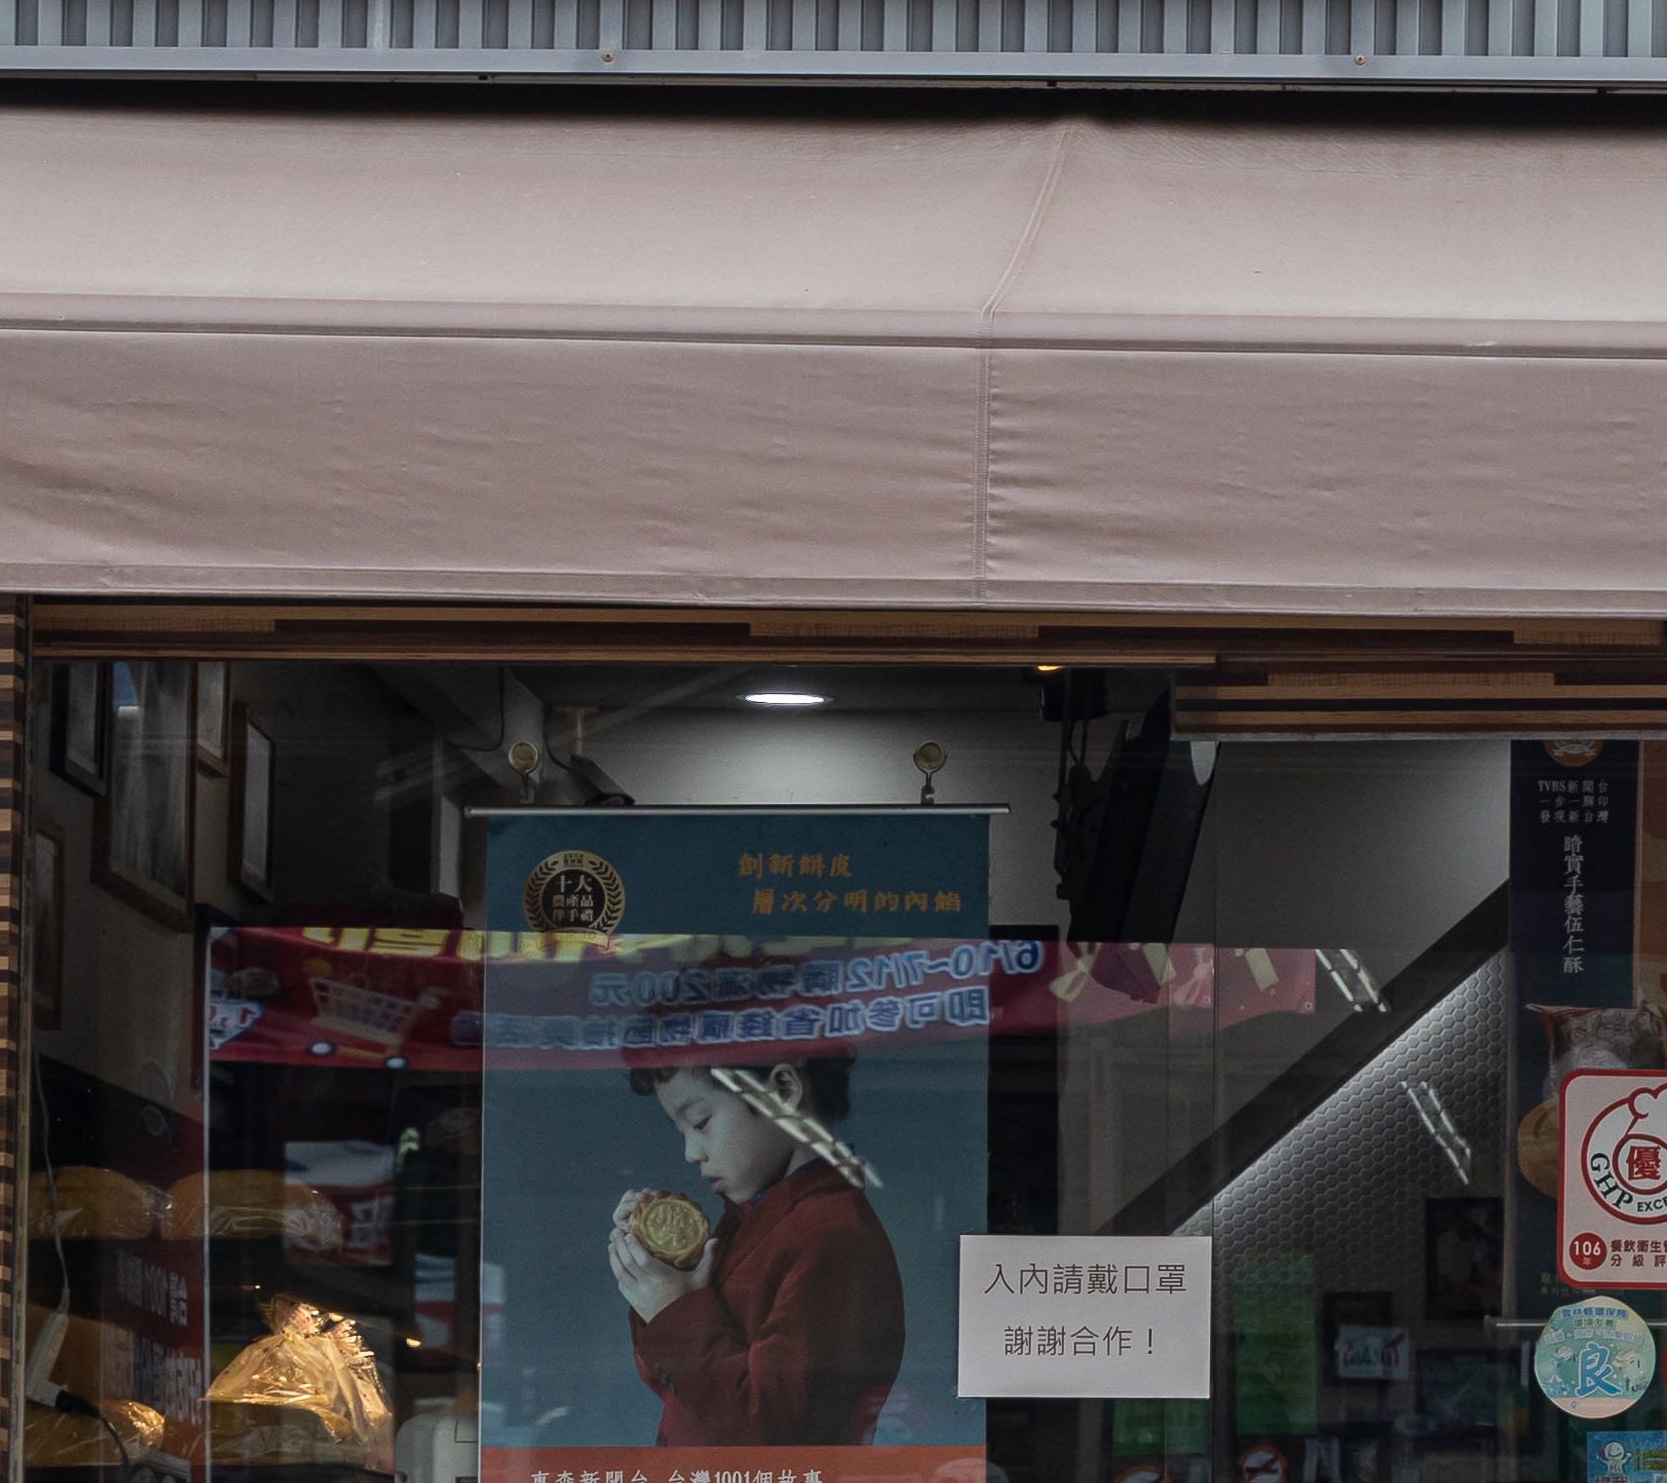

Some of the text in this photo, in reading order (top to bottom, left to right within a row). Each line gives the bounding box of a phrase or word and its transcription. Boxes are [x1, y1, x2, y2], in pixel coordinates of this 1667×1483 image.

[737, 853, 854, 879] 創新餅皮
[553, 874, 593, 894] 十大
[752, 888, 963, 915] 層次分明的內餡
[1625, 1145, 1662, 1182] 優
[1589, 1152, 1634, 1210] GHP
[1573, 1241, 1602, 1256] 106
[984, 1262, 1187, 1295] 入內請戴口罩
[1574, 1340, 1624, 1399] 良
